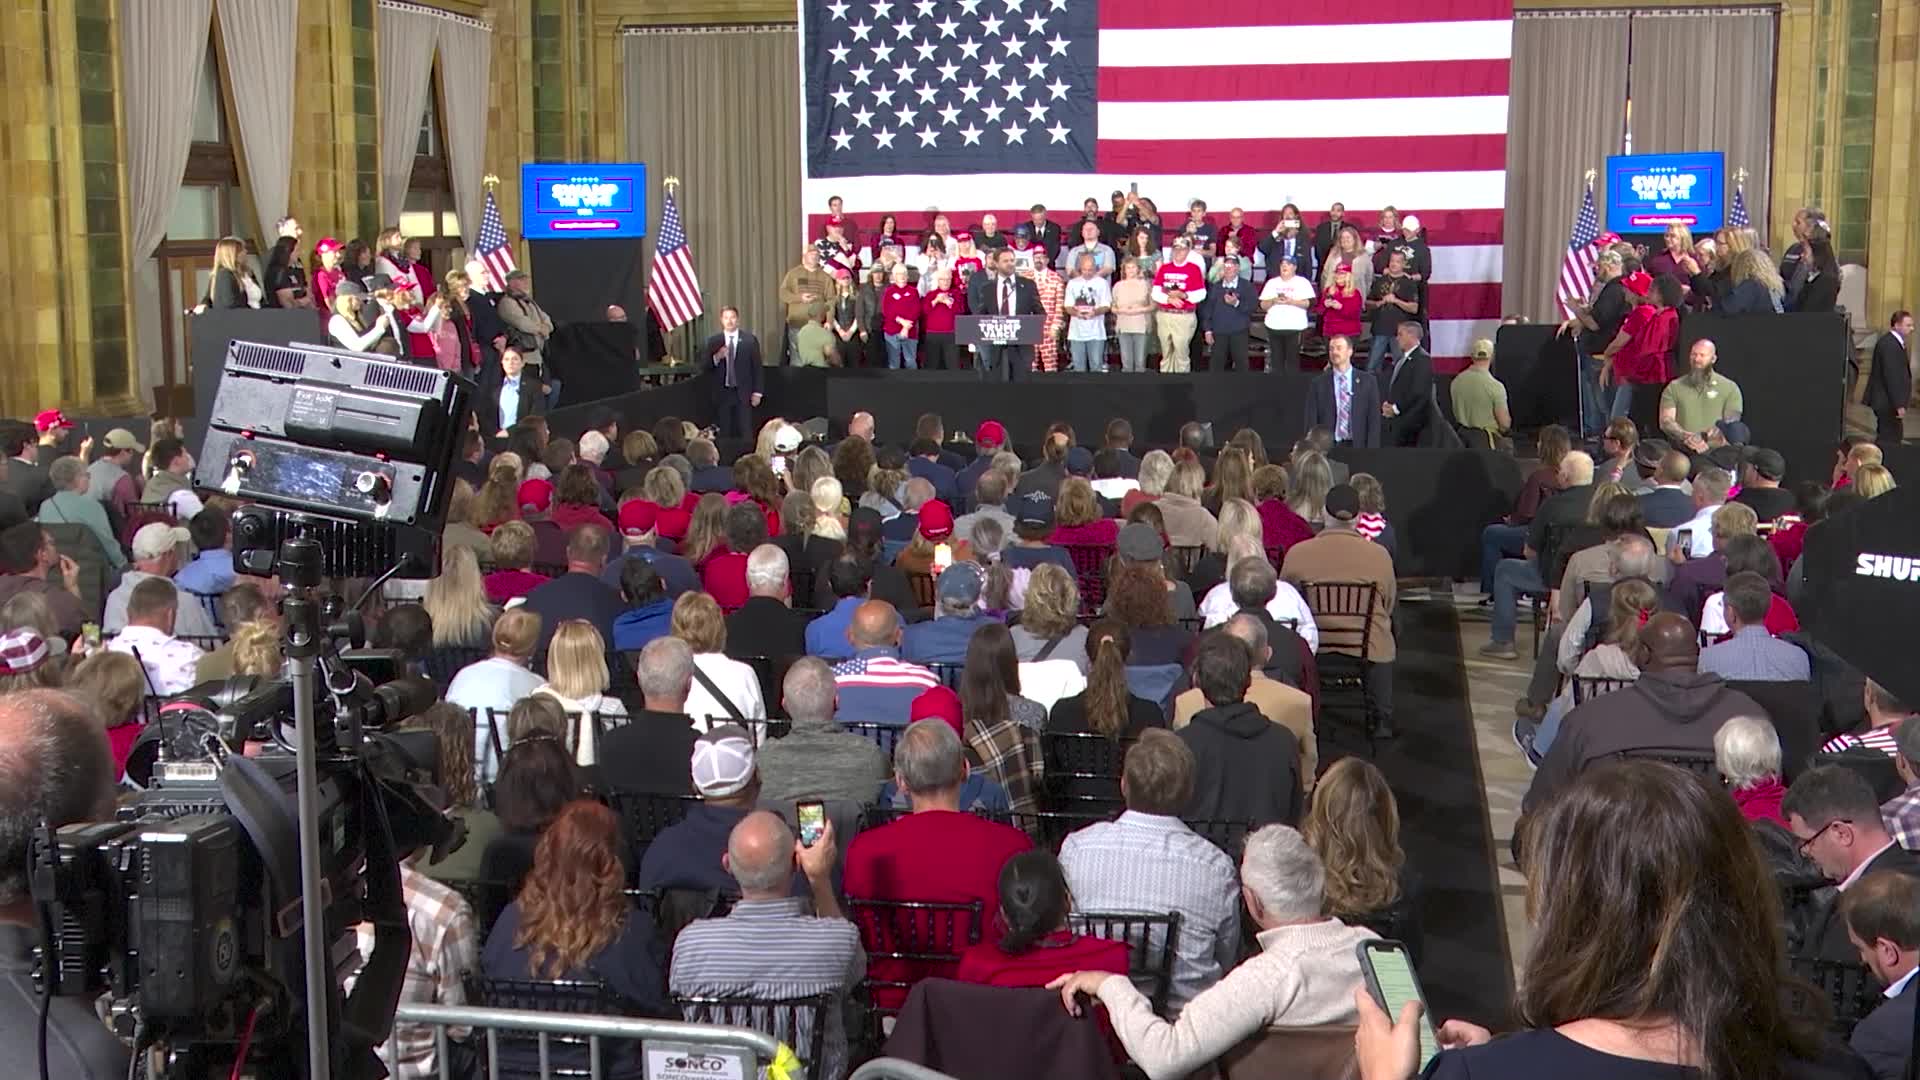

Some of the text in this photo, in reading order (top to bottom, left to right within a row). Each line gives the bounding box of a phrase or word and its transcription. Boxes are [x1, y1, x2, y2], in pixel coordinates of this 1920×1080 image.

[1631, 174, 1697, 191] SWAMP
[978, 323, 1021, 332] TRUMP
[664, 1057, 723, 1071] SONCO
